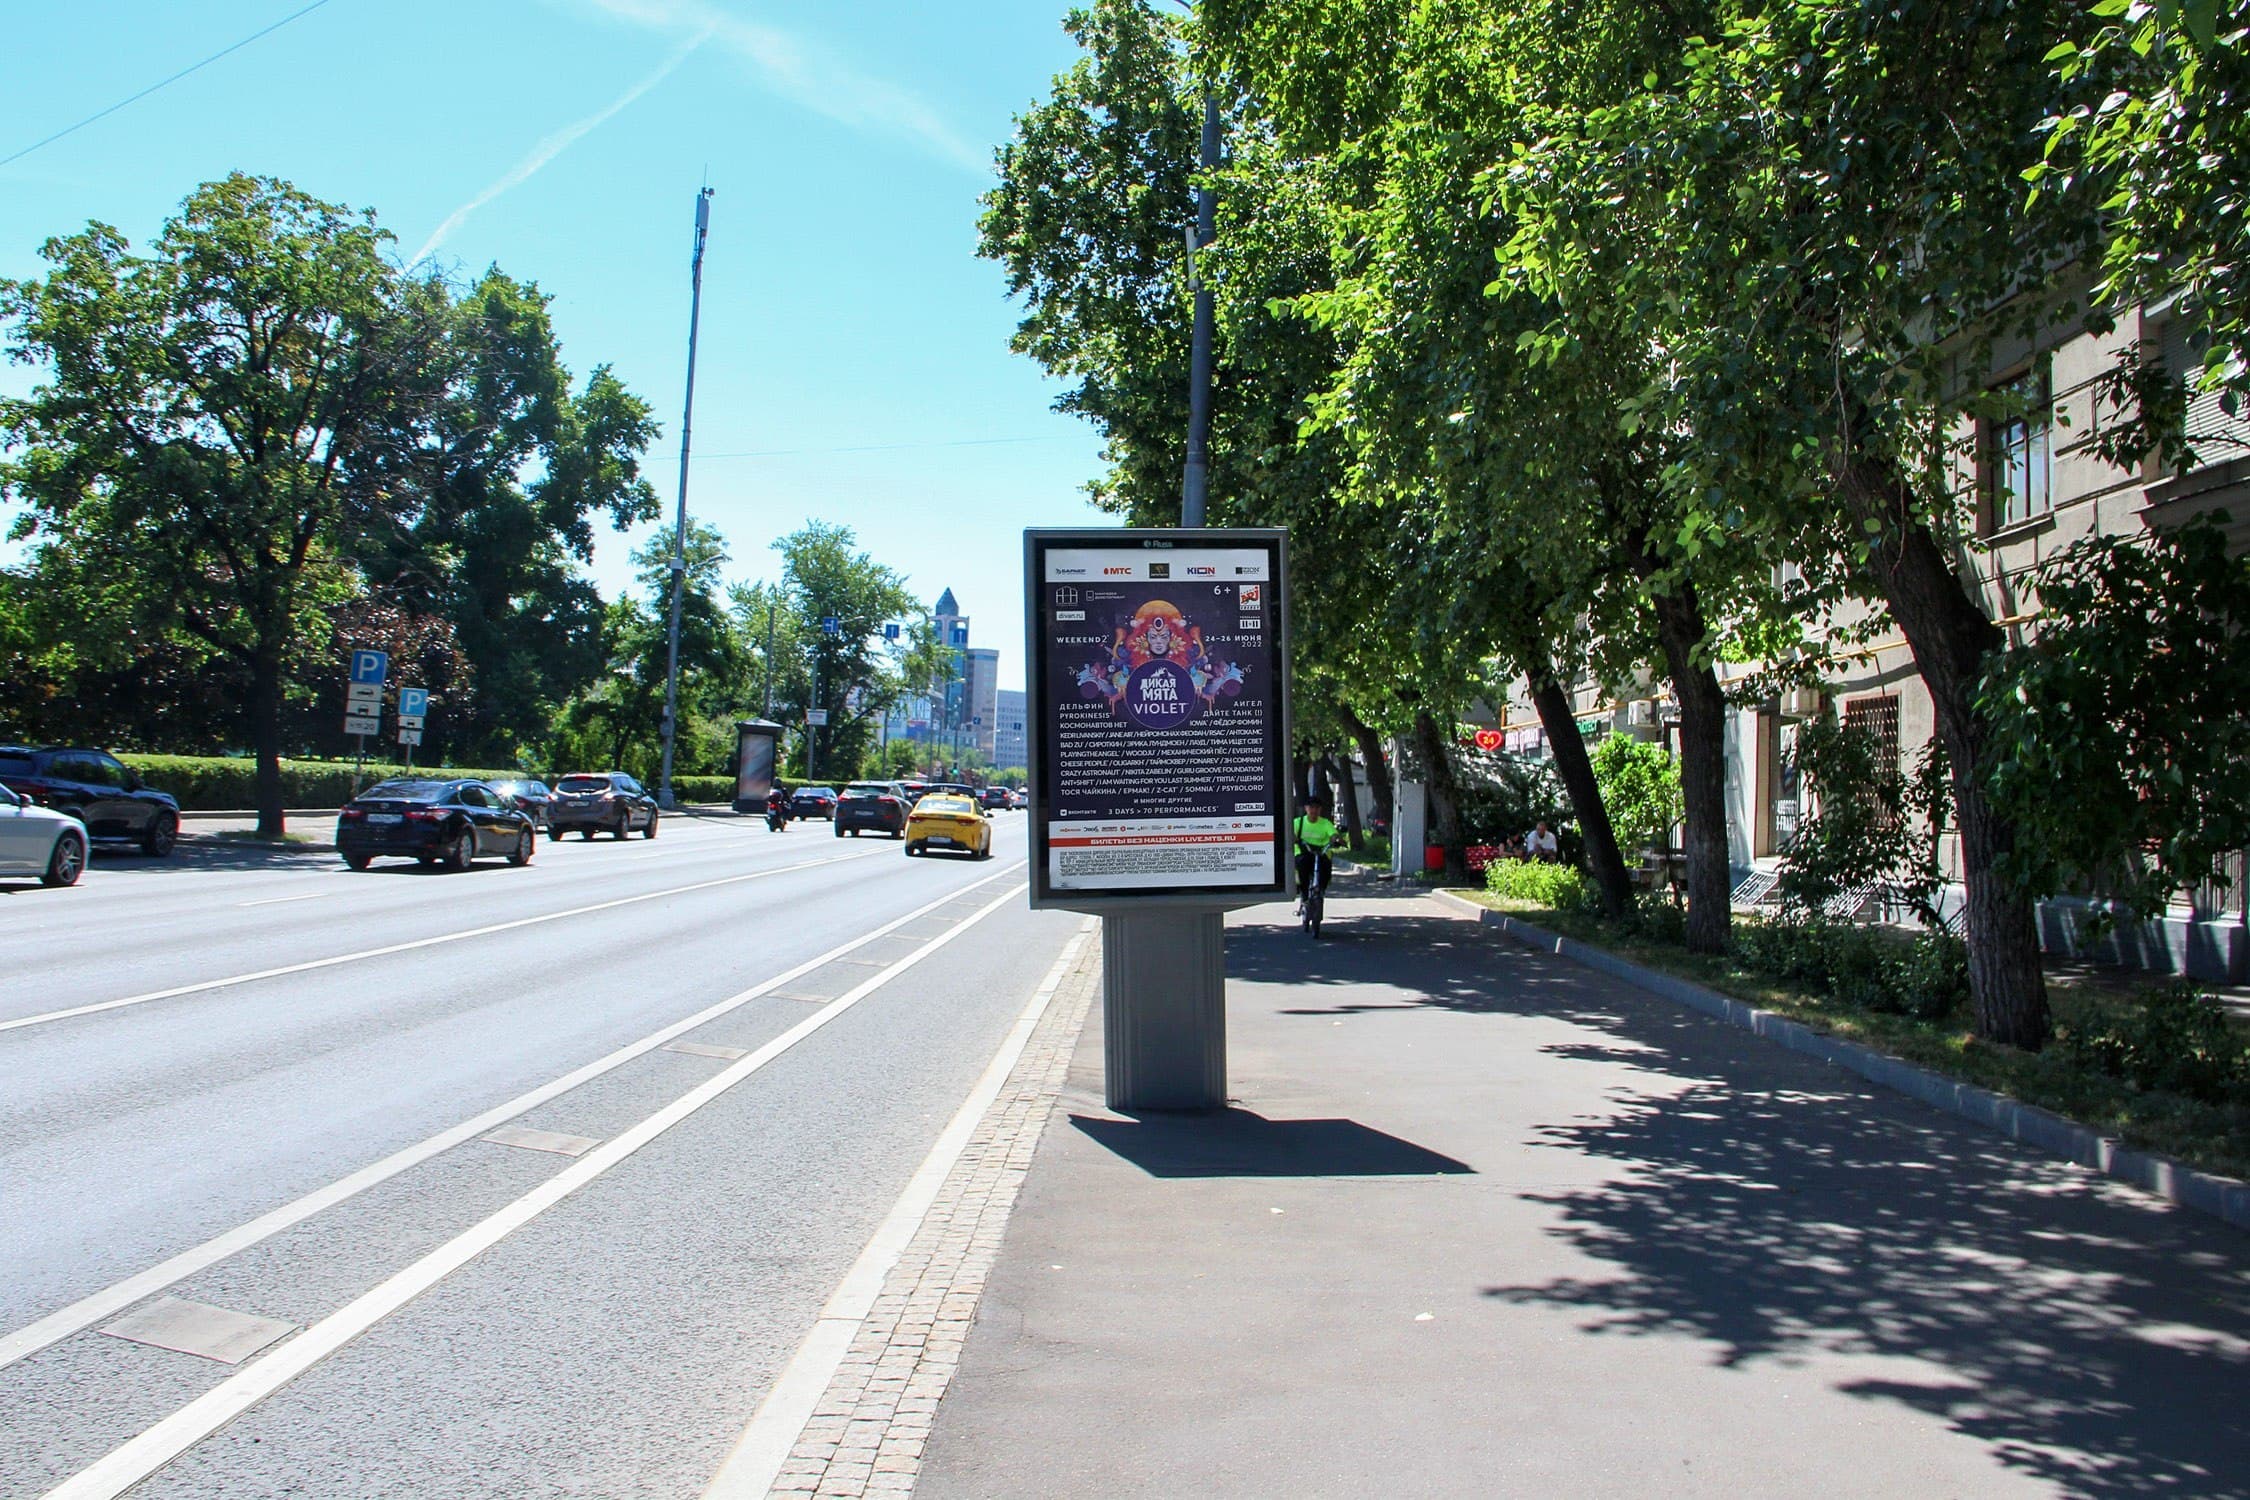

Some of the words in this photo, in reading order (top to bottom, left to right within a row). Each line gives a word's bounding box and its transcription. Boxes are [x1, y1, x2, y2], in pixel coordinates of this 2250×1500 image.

[1187, 567, 1215, 575] KION
[358, 654, 379, 679] P
[1140, 678, 1177, 690] ДИКАЯ
[1143, 688, 1178, 701] МЯТА
[406, 691, 422, 712] P
[1060, 703, 1103, 711] ДЕЛЬФИН
[1133, 703, 1186, 714] VIOLET
[1202, 709, 1229, 717] ДАЙТЕ
[1213, 719, 1236, 727] ФЁДОР
[1483, 735, 1494, 744] 24
[1160, 747, 1214, 755] МЕХАНИЧЕСКИЙ
[1081, 787, 1116, 795] ЧАЙКИНА
[1154, 806, 1216, 814] PERFORMANCES
[1143, 836, 1184, 844] НАЦЕНКИ
